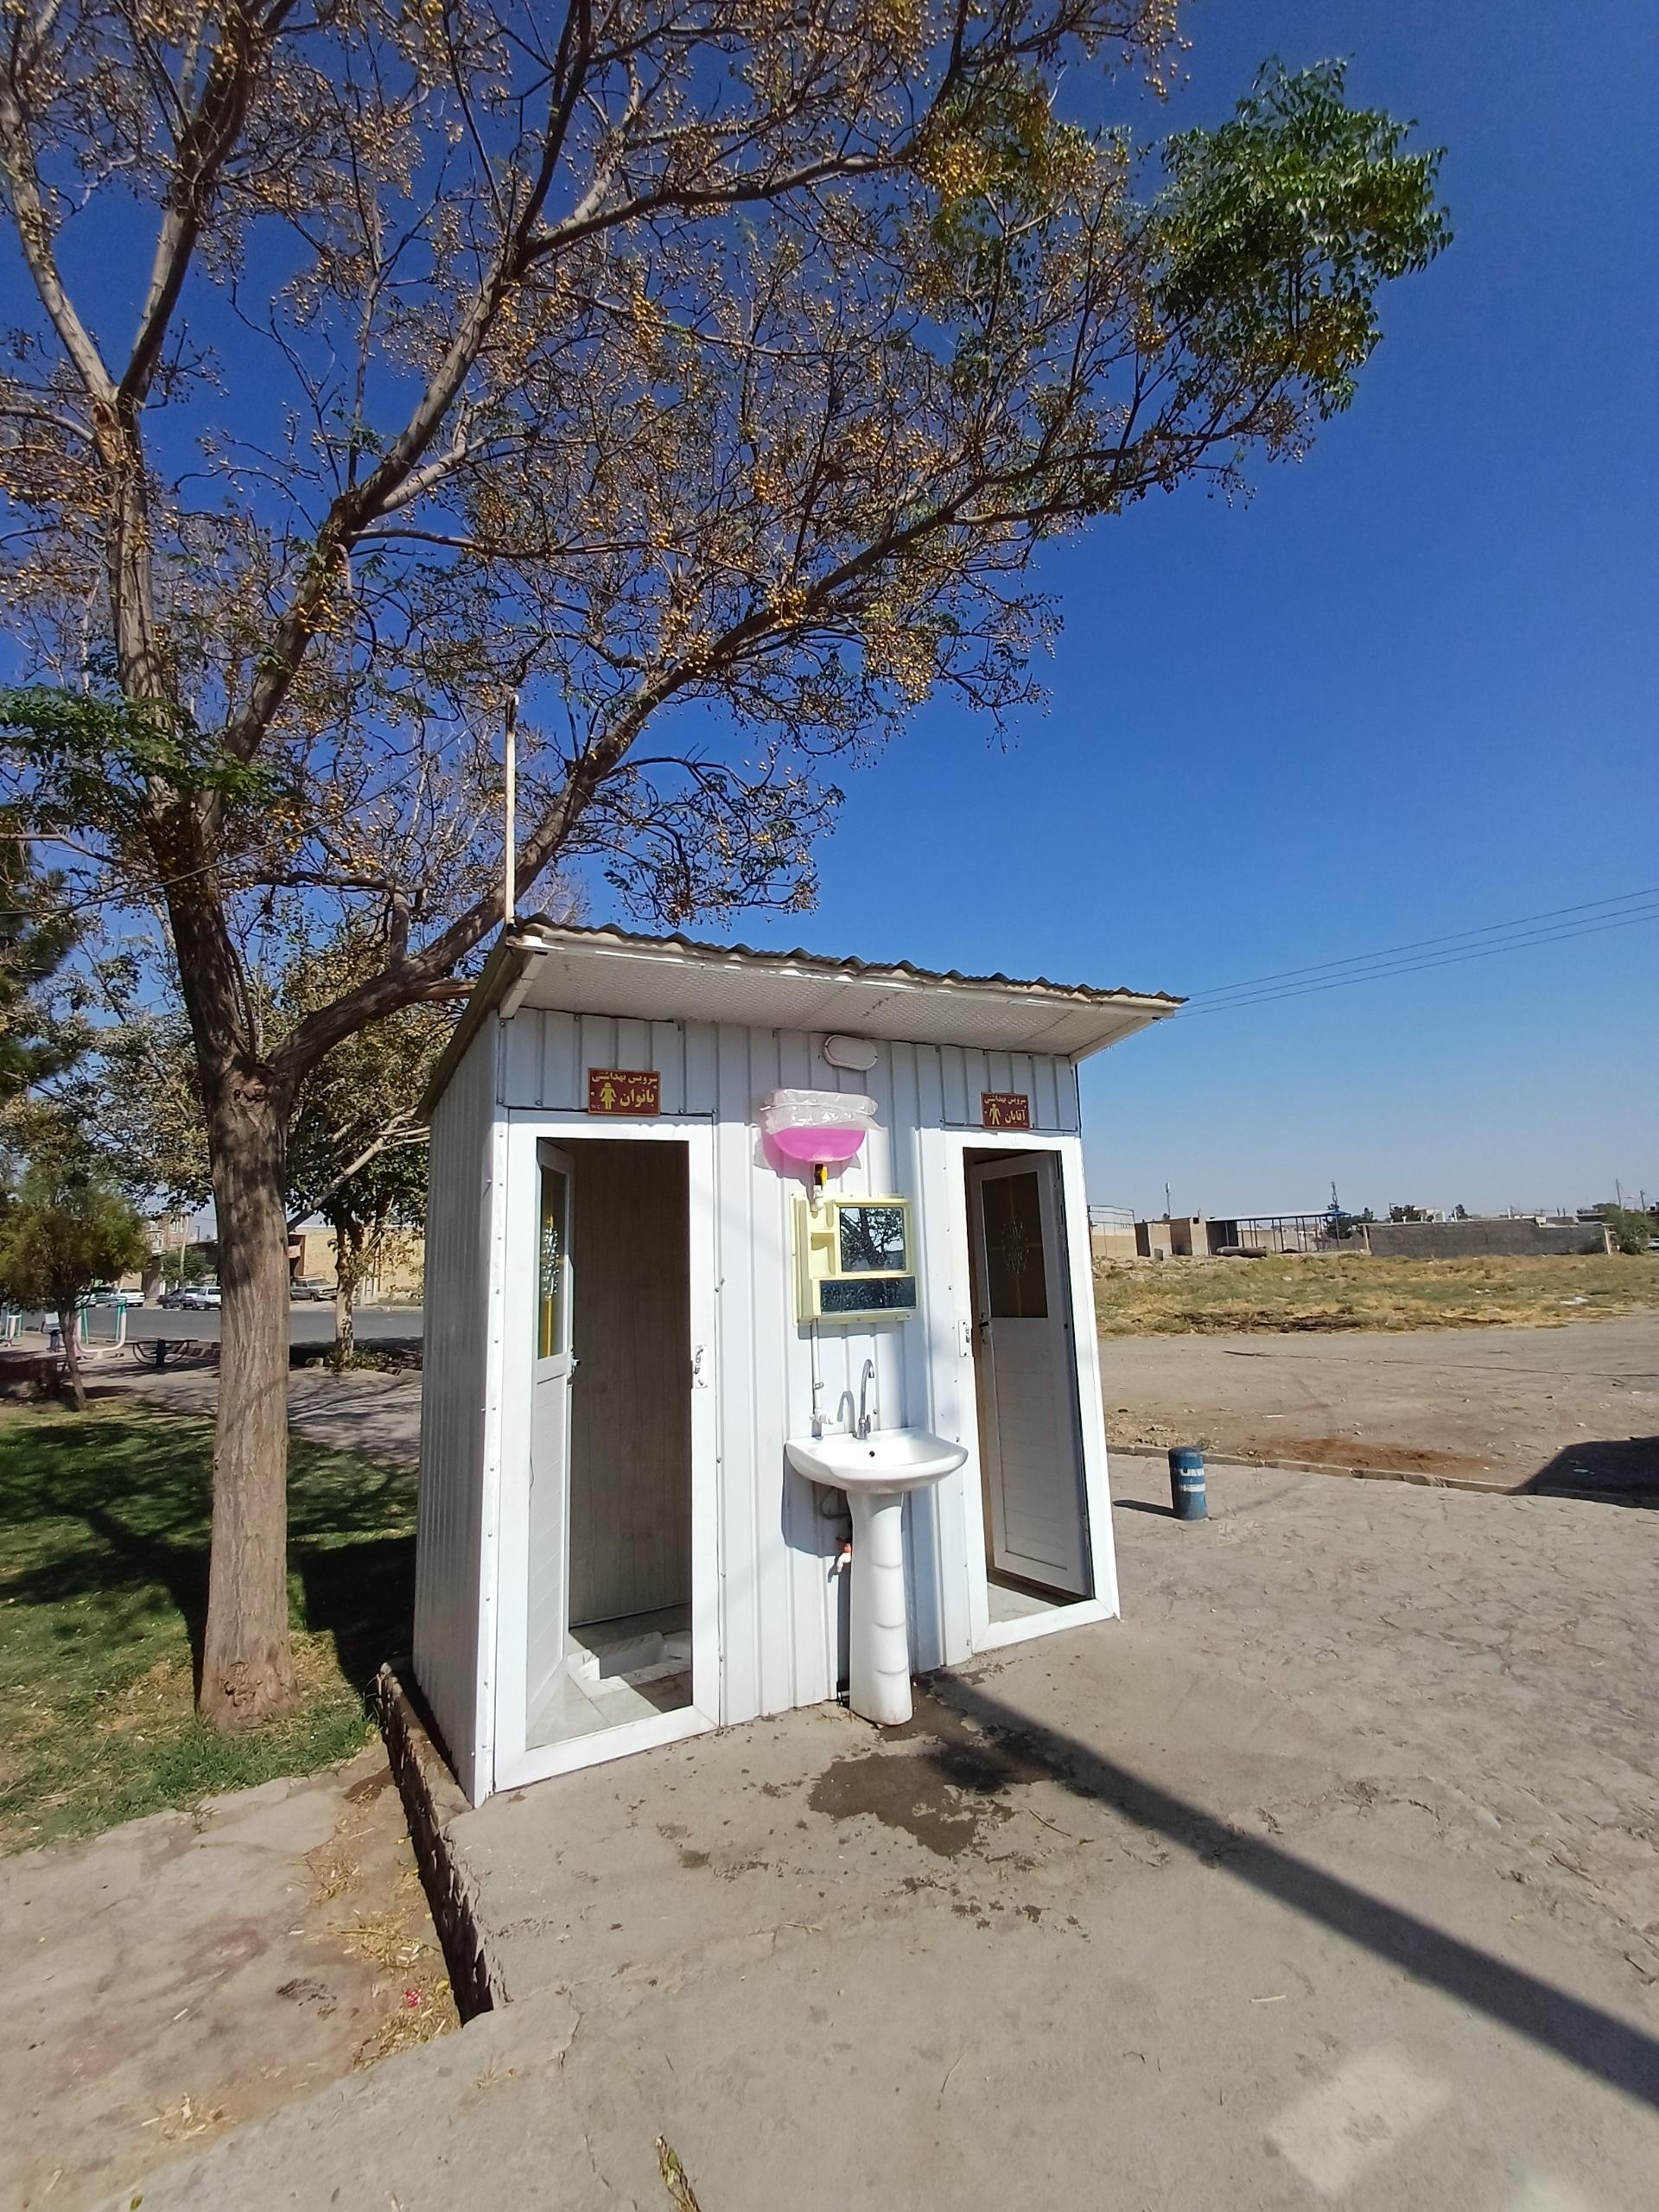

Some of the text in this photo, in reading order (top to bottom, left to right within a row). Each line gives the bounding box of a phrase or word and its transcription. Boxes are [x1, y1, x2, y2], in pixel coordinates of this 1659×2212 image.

[591, 1072, 658, 1084] سرویس بهداشتی
[620, 1089, 654, 1107] بانوان
